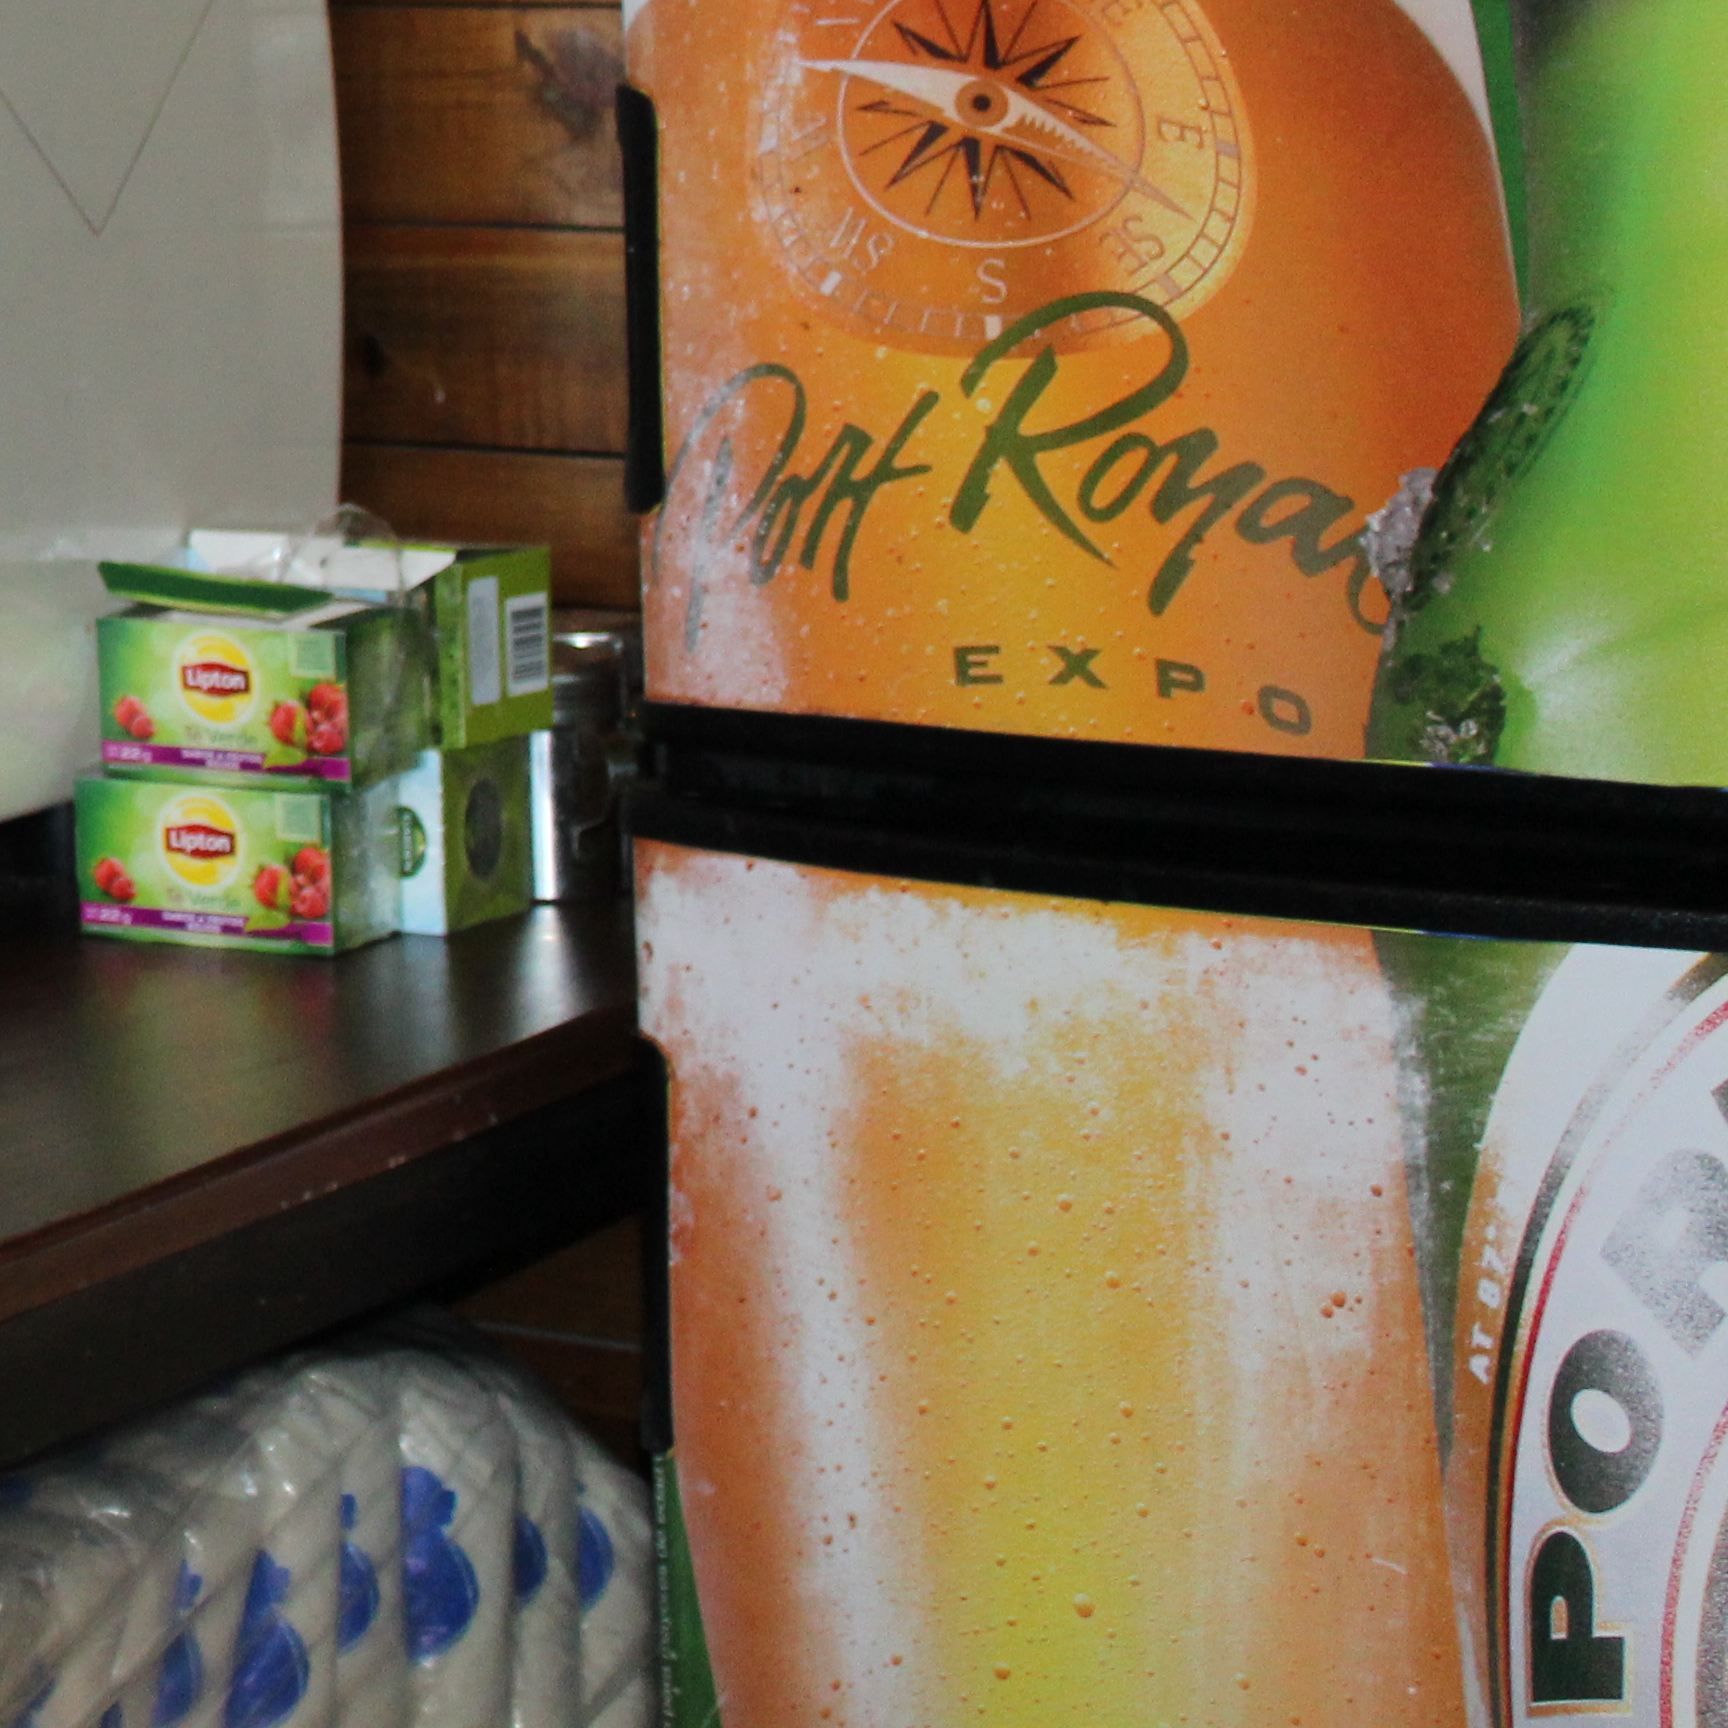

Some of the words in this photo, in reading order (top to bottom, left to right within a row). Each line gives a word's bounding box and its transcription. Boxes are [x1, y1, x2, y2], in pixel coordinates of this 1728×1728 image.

[1157, 114, 1206, 152] E
[975, 256, 1008, 305] S
[652, 362, 940, 653] Port
[185, 668, 246, 692] Lipton
[953, 644, 1313, 737] EXPO
[170, 830, 232, 853] Lipton
